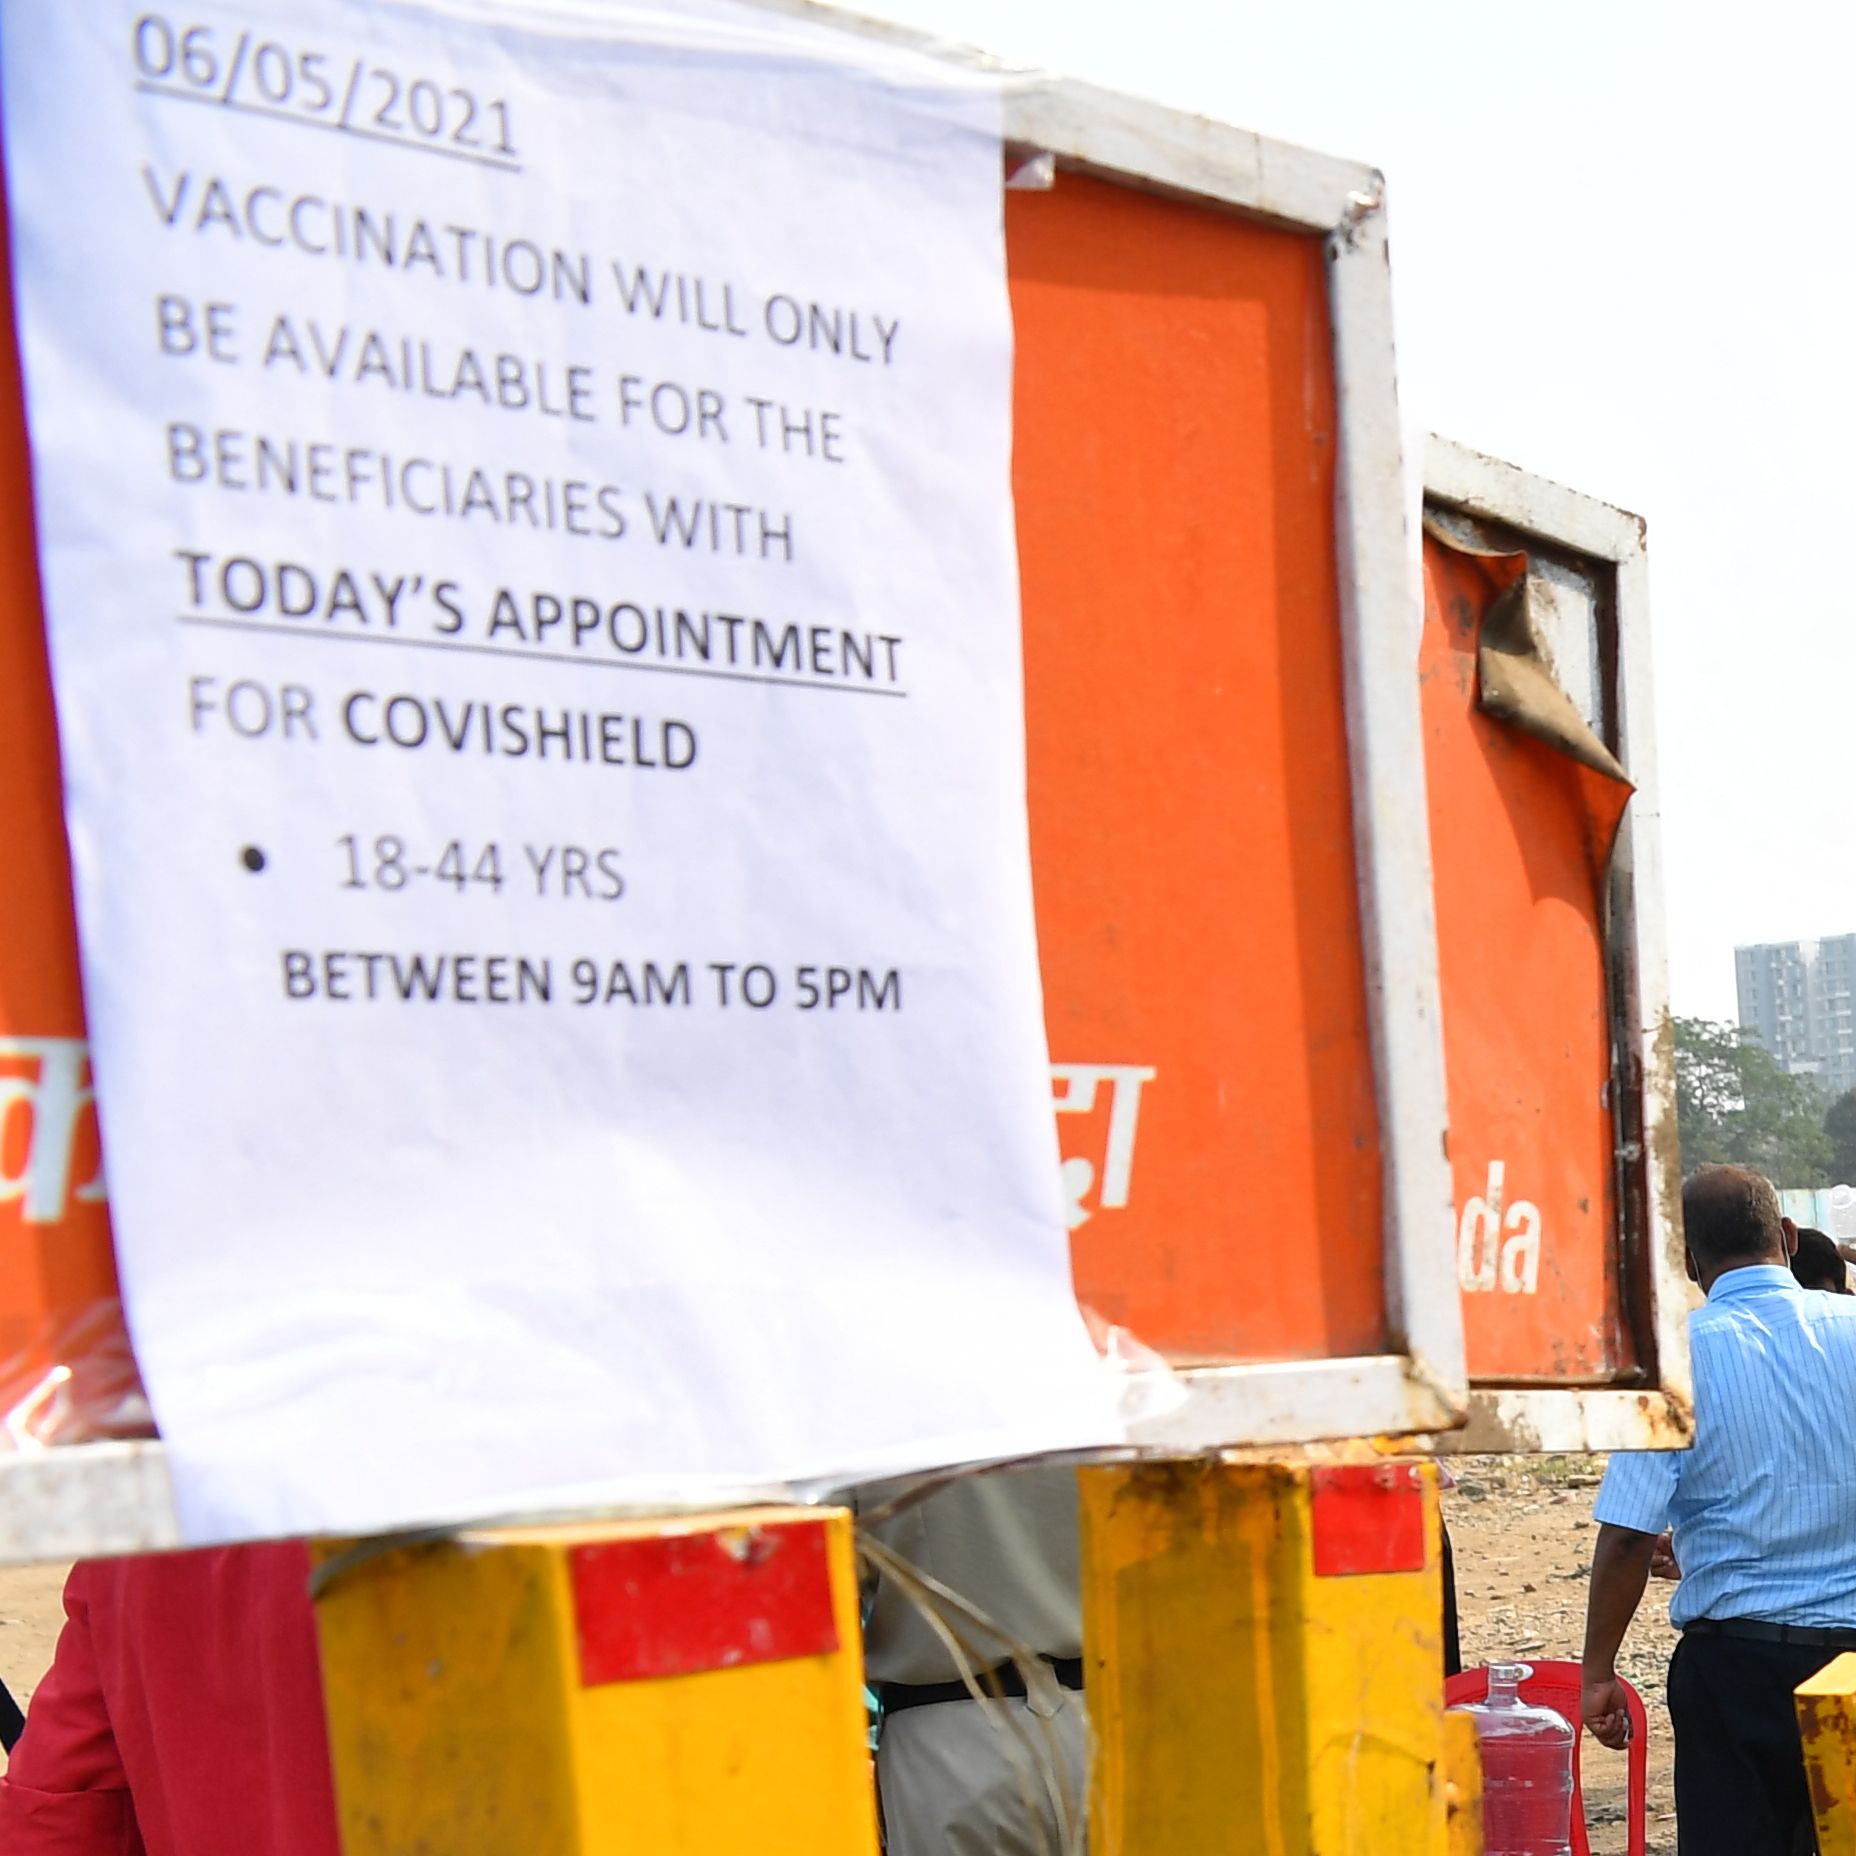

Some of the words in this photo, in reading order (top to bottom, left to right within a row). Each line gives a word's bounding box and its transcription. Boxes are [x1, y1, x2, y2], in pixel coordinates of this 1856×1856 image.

[131, 13, 518, 158] 06/05/2021
[143, 165, 591, 305] VACCINATION
[612, 260, 747, 338] WILL
[764, 293, 899, 366] ONLY
[156, 295, 239, 363] BE
[263, 315, 597, 422] AVAILABLE
[618, 376, 729, 442] FOR
[745, 397, 846, 462] THE
[166, 423, 627, 539] BENEFICIARIES
[643, 492, 793, 563] WITH
[174, 551, 464, 636] TODAY'S
[487, 588, 904, 682] APPOINTMENT
[188, 676, 318, 742] FOR
[343, 691, 698, 771] COVISHIELD
[336, 834, 503, 896] 18-44
[524, 843, 627, 902] YRS
[282, 949, 553, 1004] BETWEEN
[571, 958, 692, 1007] 9AM
[709, 962, 777, 1010] TO
[794, 966, 901, 1012] 5PM
[1453, 1160, 1542, 1294] da
